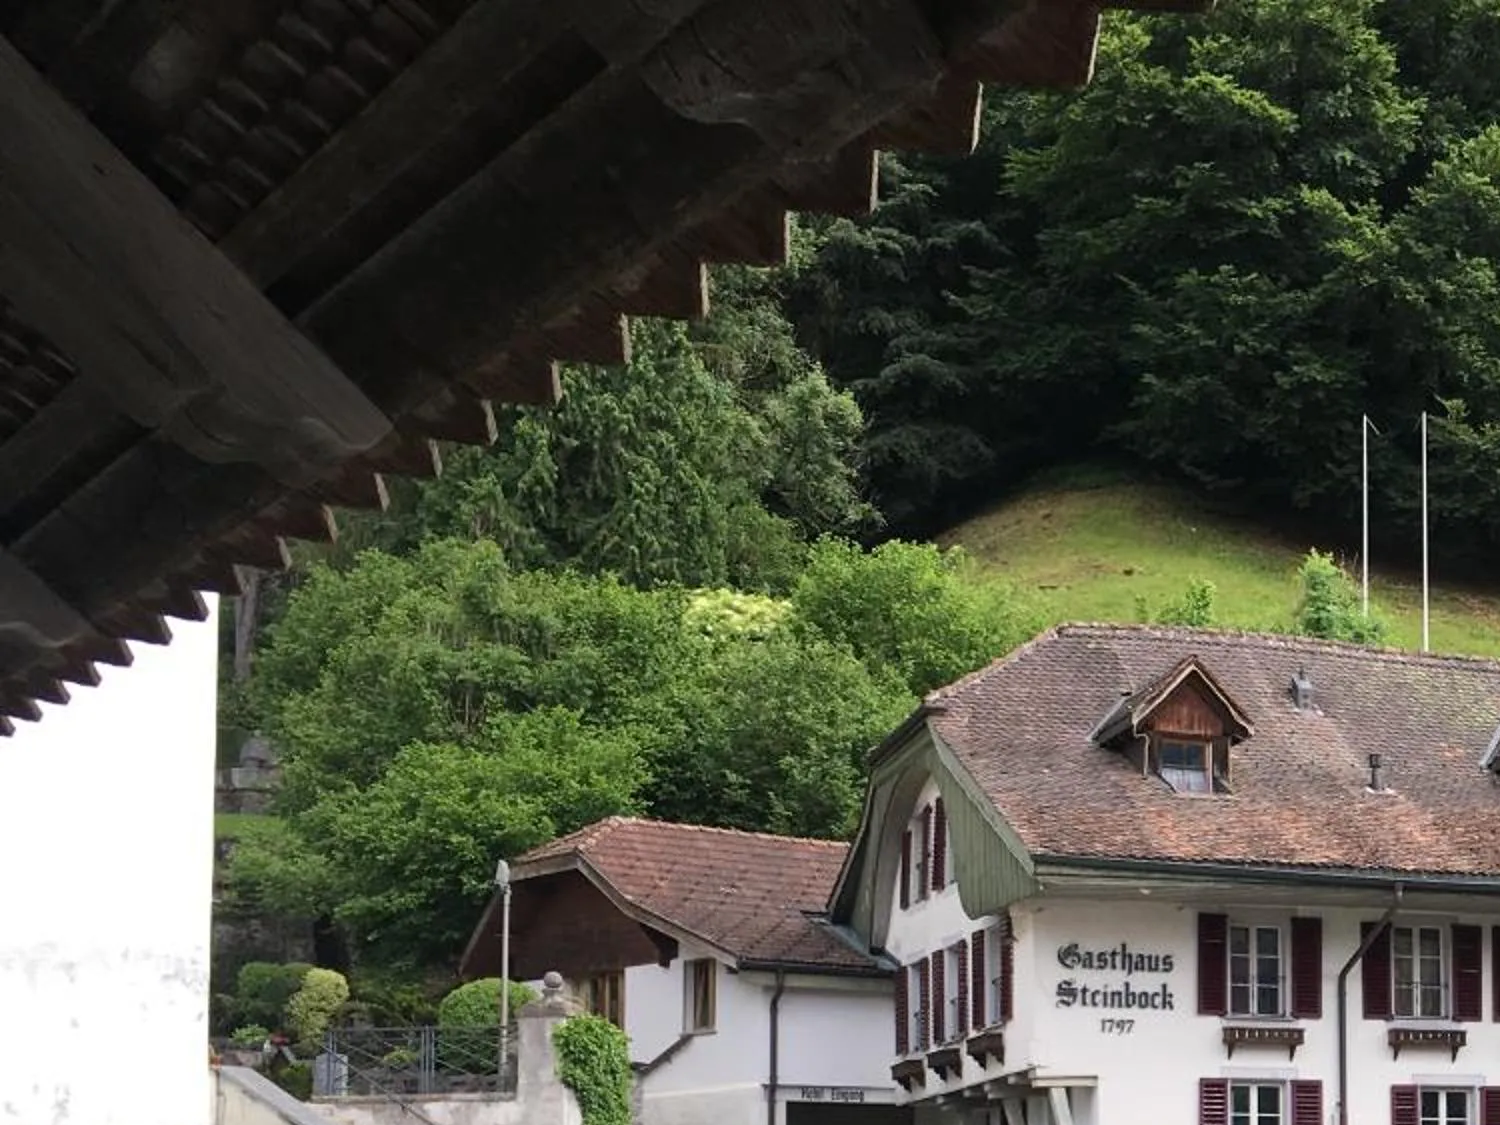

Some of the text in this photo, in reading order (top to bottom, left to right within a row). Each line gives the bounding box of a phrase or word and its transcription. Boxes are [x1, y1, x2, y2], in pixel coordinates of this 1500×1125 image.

[1057, 942, 1174, 975] Gasthaus
[1055, 979, 1174, 1010] Steinbock
[1101, 1018, 1135, 1035] 1797
